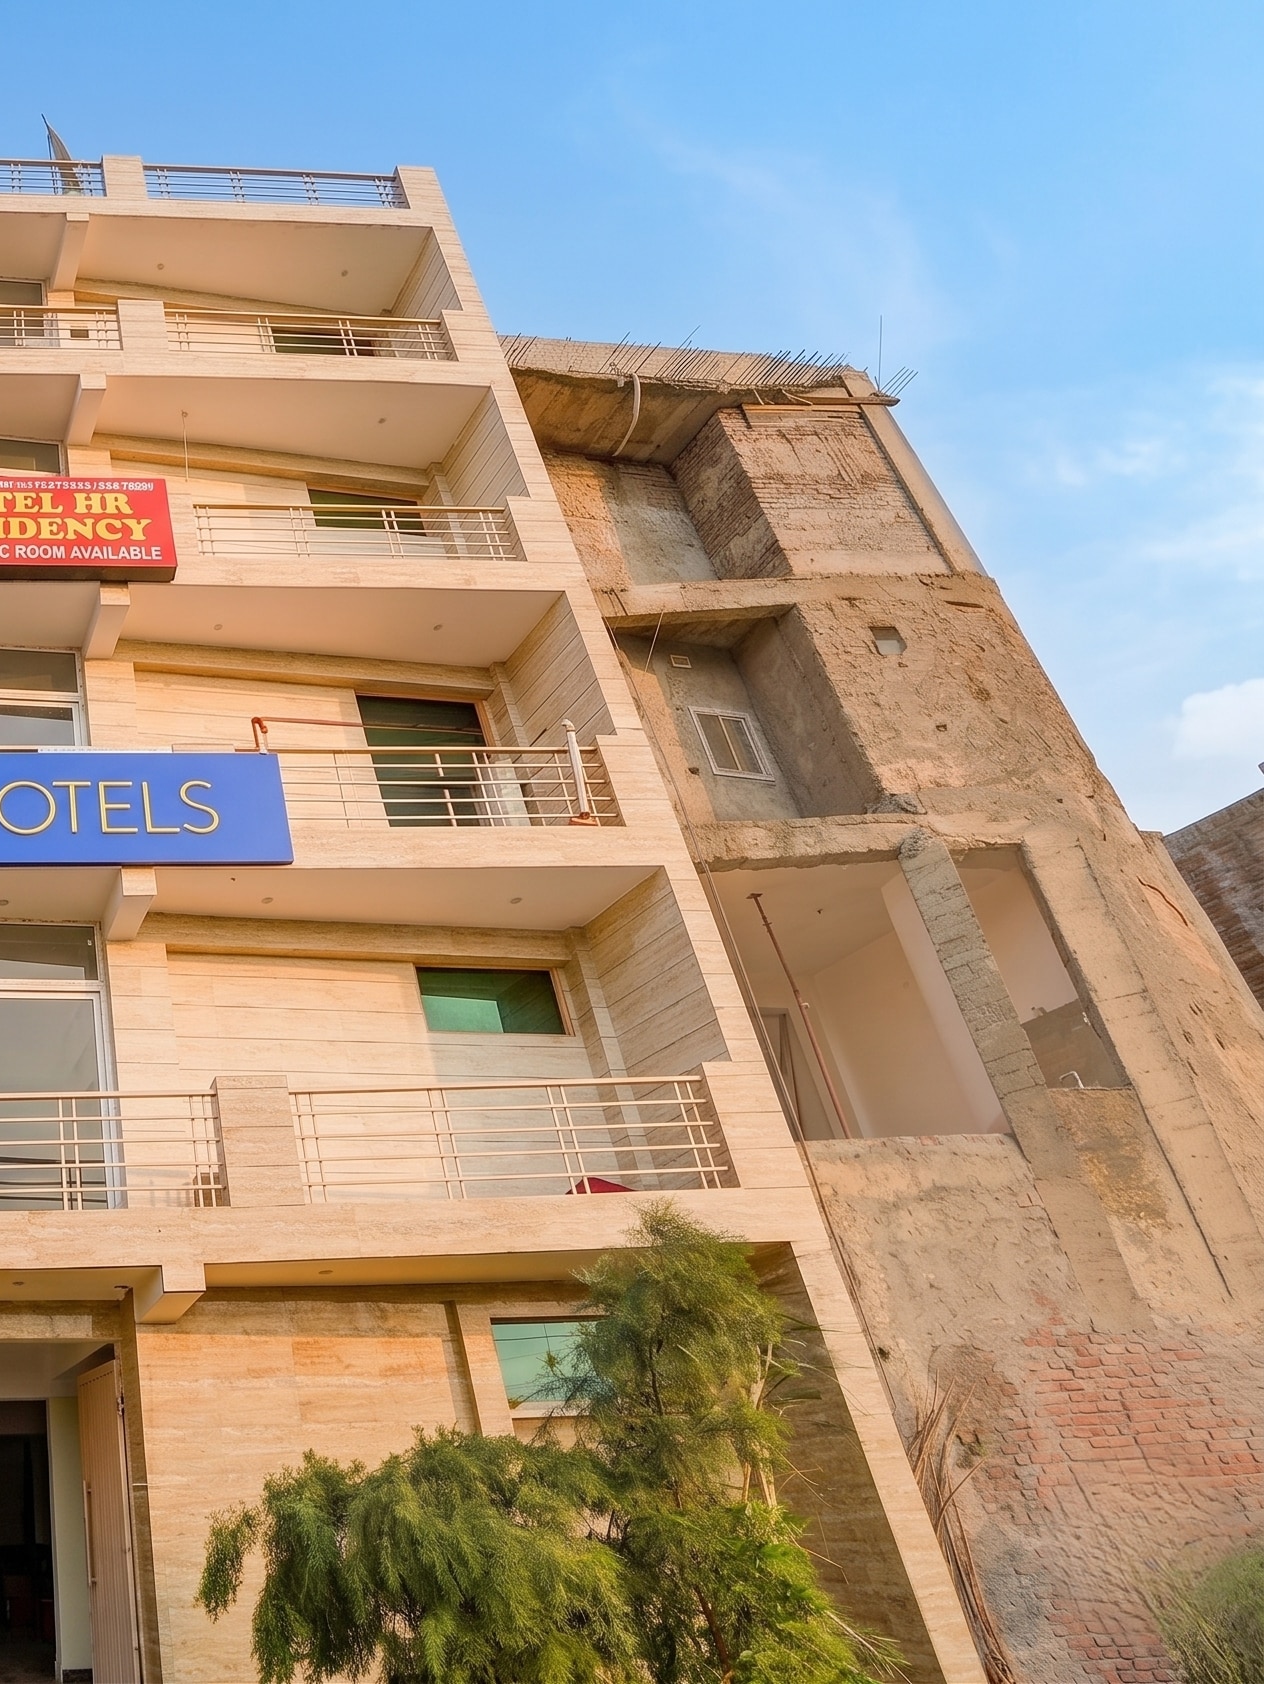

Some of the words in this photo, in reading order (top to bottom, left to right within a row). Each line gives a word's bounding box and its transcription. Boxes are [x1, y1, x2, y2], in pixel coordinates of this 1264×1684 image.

[73, 492, 134, 515] HR
[15, 544, 66, 559] ROOM
[70, 544, 163, 560] AVAILABLE
